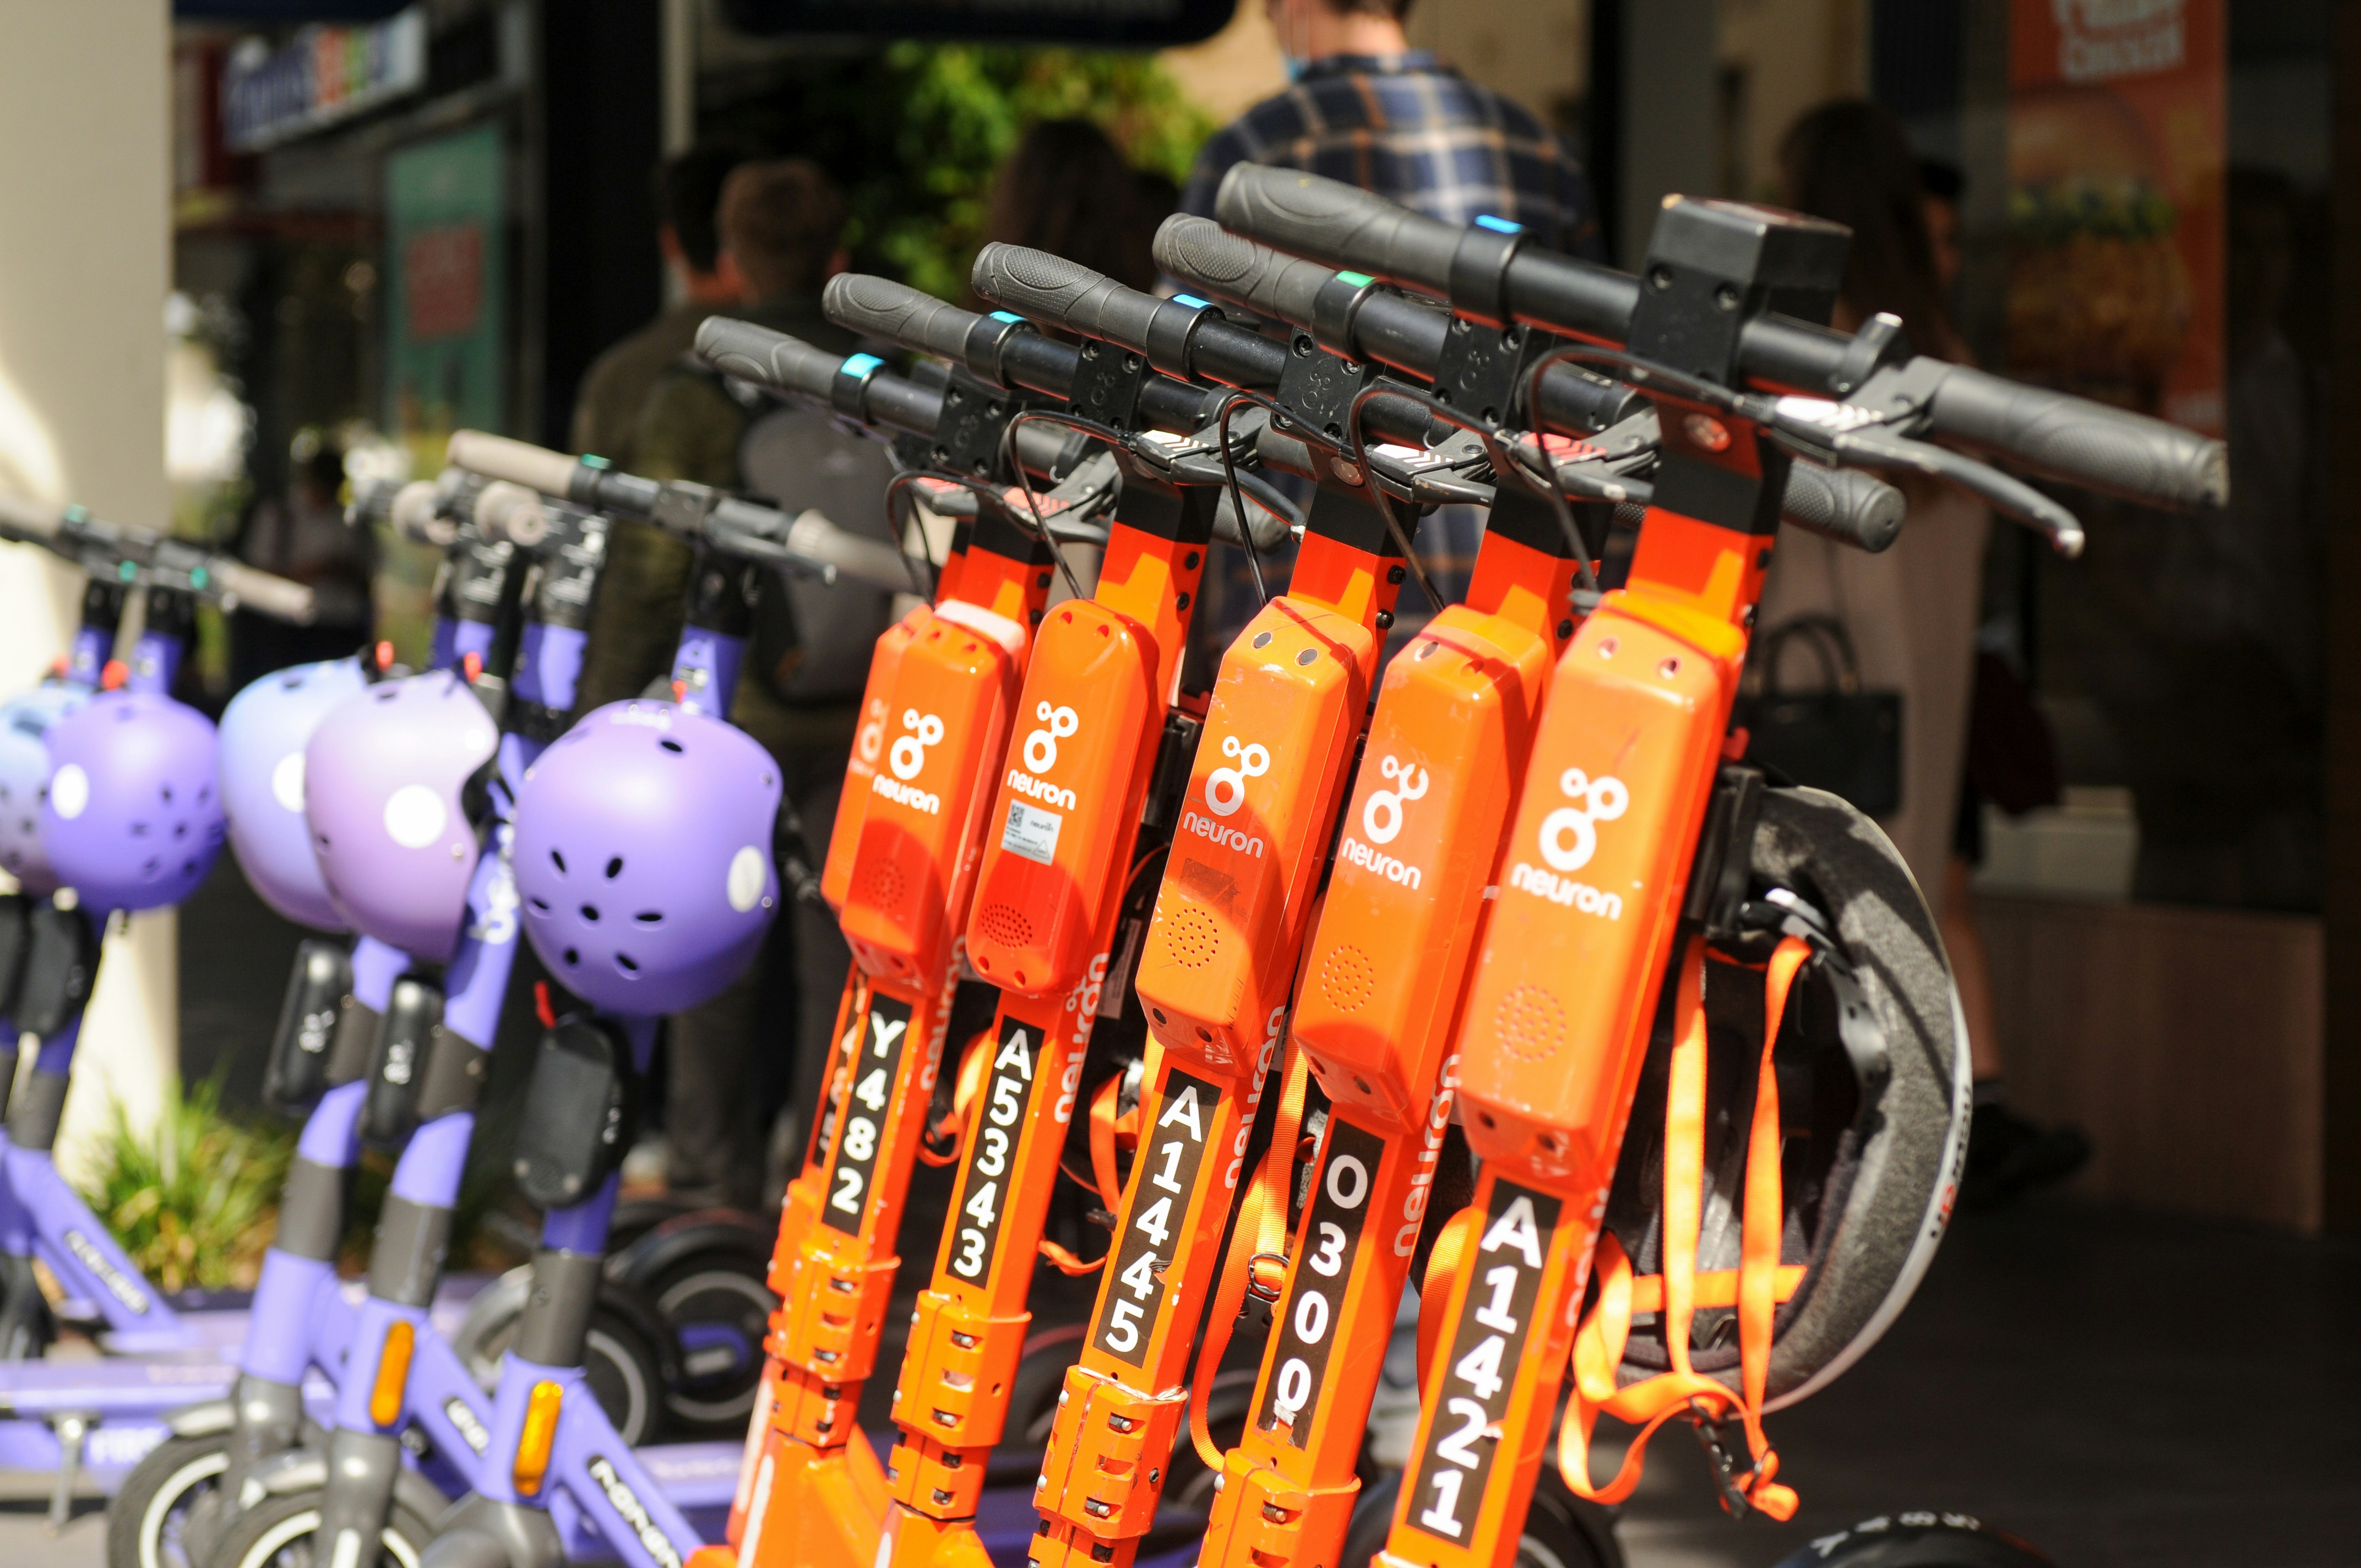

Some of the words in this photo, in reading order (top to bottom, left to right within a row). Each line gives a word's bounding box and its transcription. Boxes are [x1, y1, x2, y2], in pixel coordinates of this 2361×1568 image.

[873, 774, 940, 815] neuron
[1008, 769, 1076, 810] neuron
[1183, 812, 1264, 859] neuron
[1342, 837, 1422, 890] neuron
[1510, 862, 1623, 920] neuron
[831, 1006, 906, 1215] Y482
[1053, 952, 1109, 1123] neuron
[954, 1028, 1032, 1277] A5343
[1105, 1085, 1202, 1353] A1445
[1394, 1054, 1462, 1257] neuron
[1420, 1197, 1543, 1538] A1421
